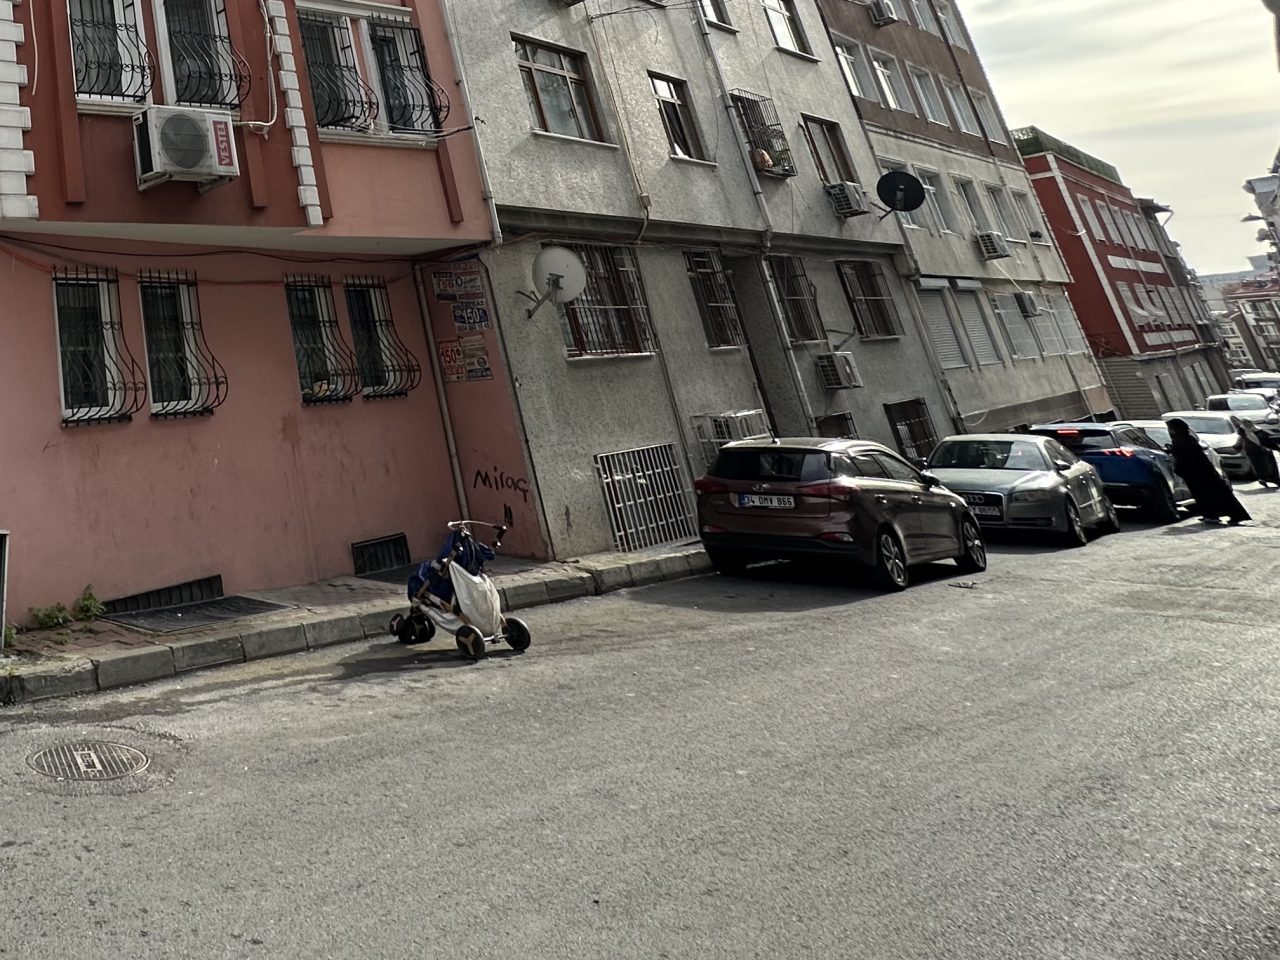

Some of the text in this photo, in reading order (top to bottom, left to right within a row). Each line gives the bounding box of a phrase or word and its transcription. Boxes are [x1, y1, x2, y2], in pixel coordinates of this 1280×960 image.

[217, 122, 230, 165] VESTEL
[464, 308, 479, 324] 150
[441, 348, 456, 365] 150
